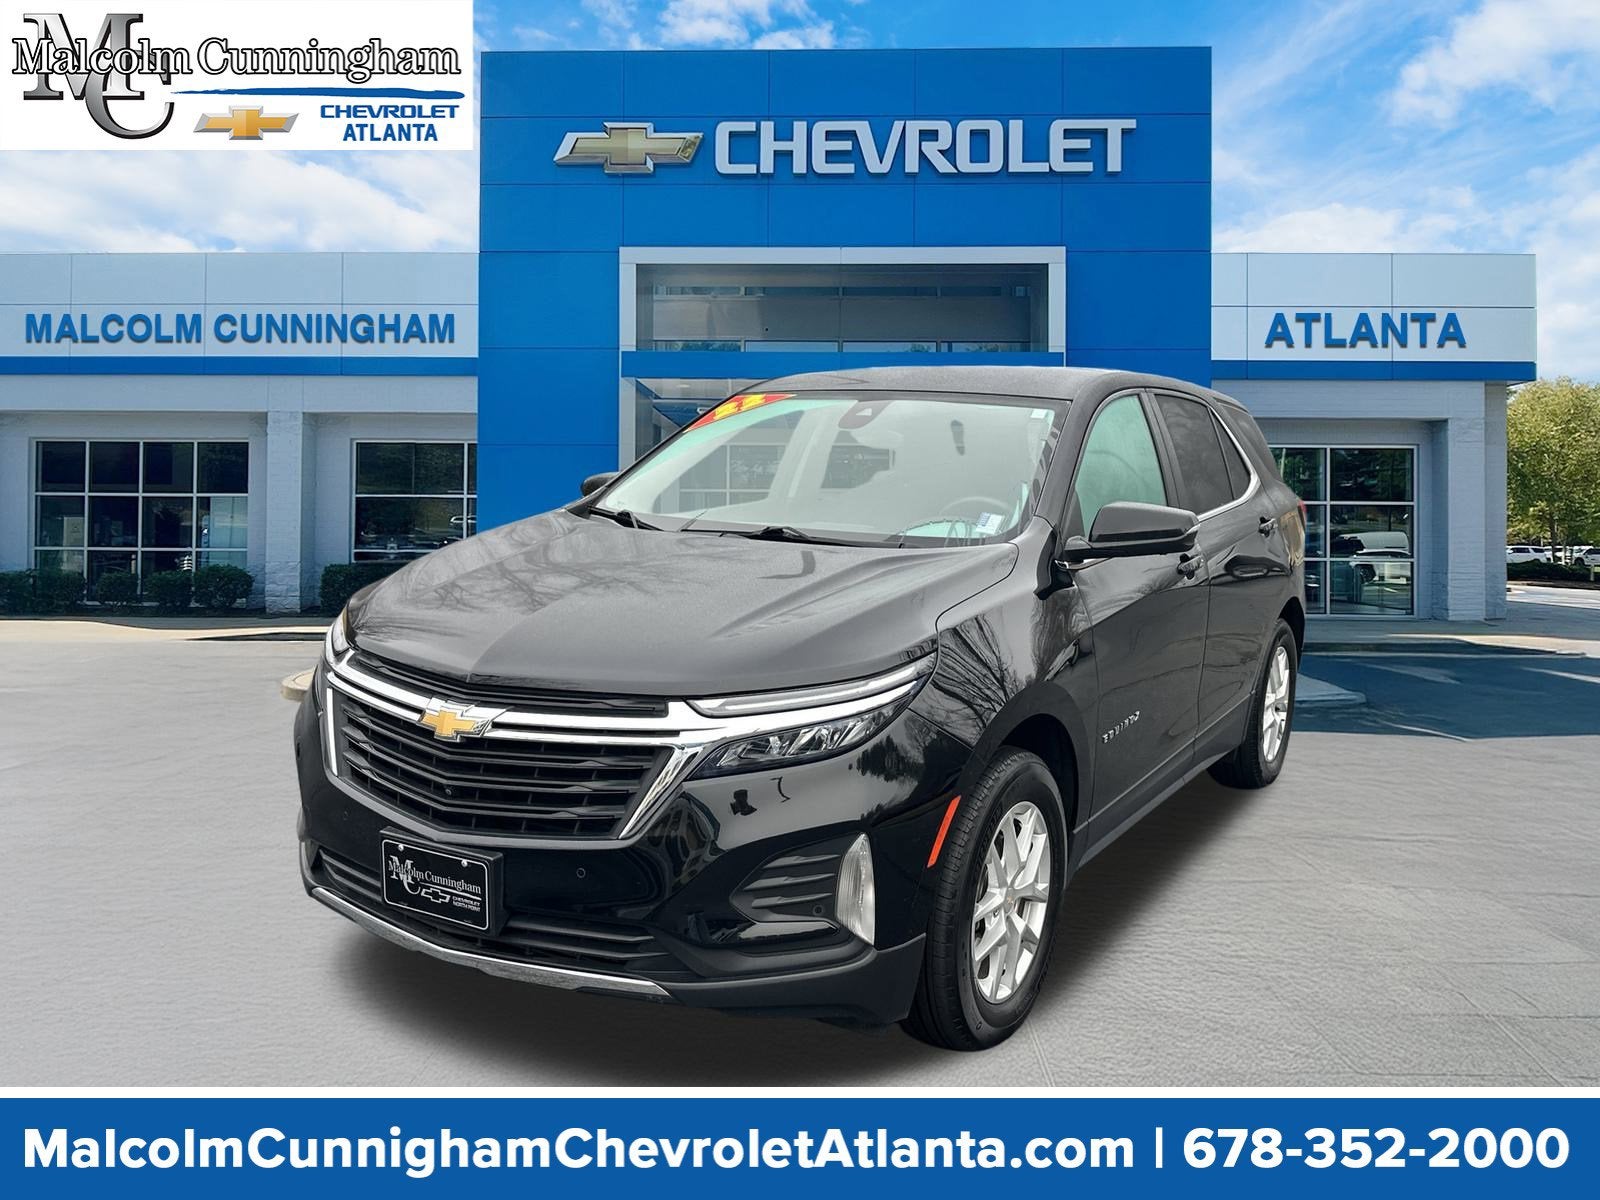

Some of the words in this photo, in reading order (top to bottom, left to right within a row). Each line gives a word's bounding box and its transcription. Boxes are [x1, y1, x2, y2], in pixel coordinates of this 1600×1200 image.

[716, 119, 1136, 174] CHEVROLET
[25, 313, 201, 343] MALCOLM
[213, 313, 455, 343] CUNNINGHAM
[1264, 312, 1466, 348] ATLANTA
[388, 860, 425, 881] Malcolm
[424, 870, 481, 894] Cunningham
